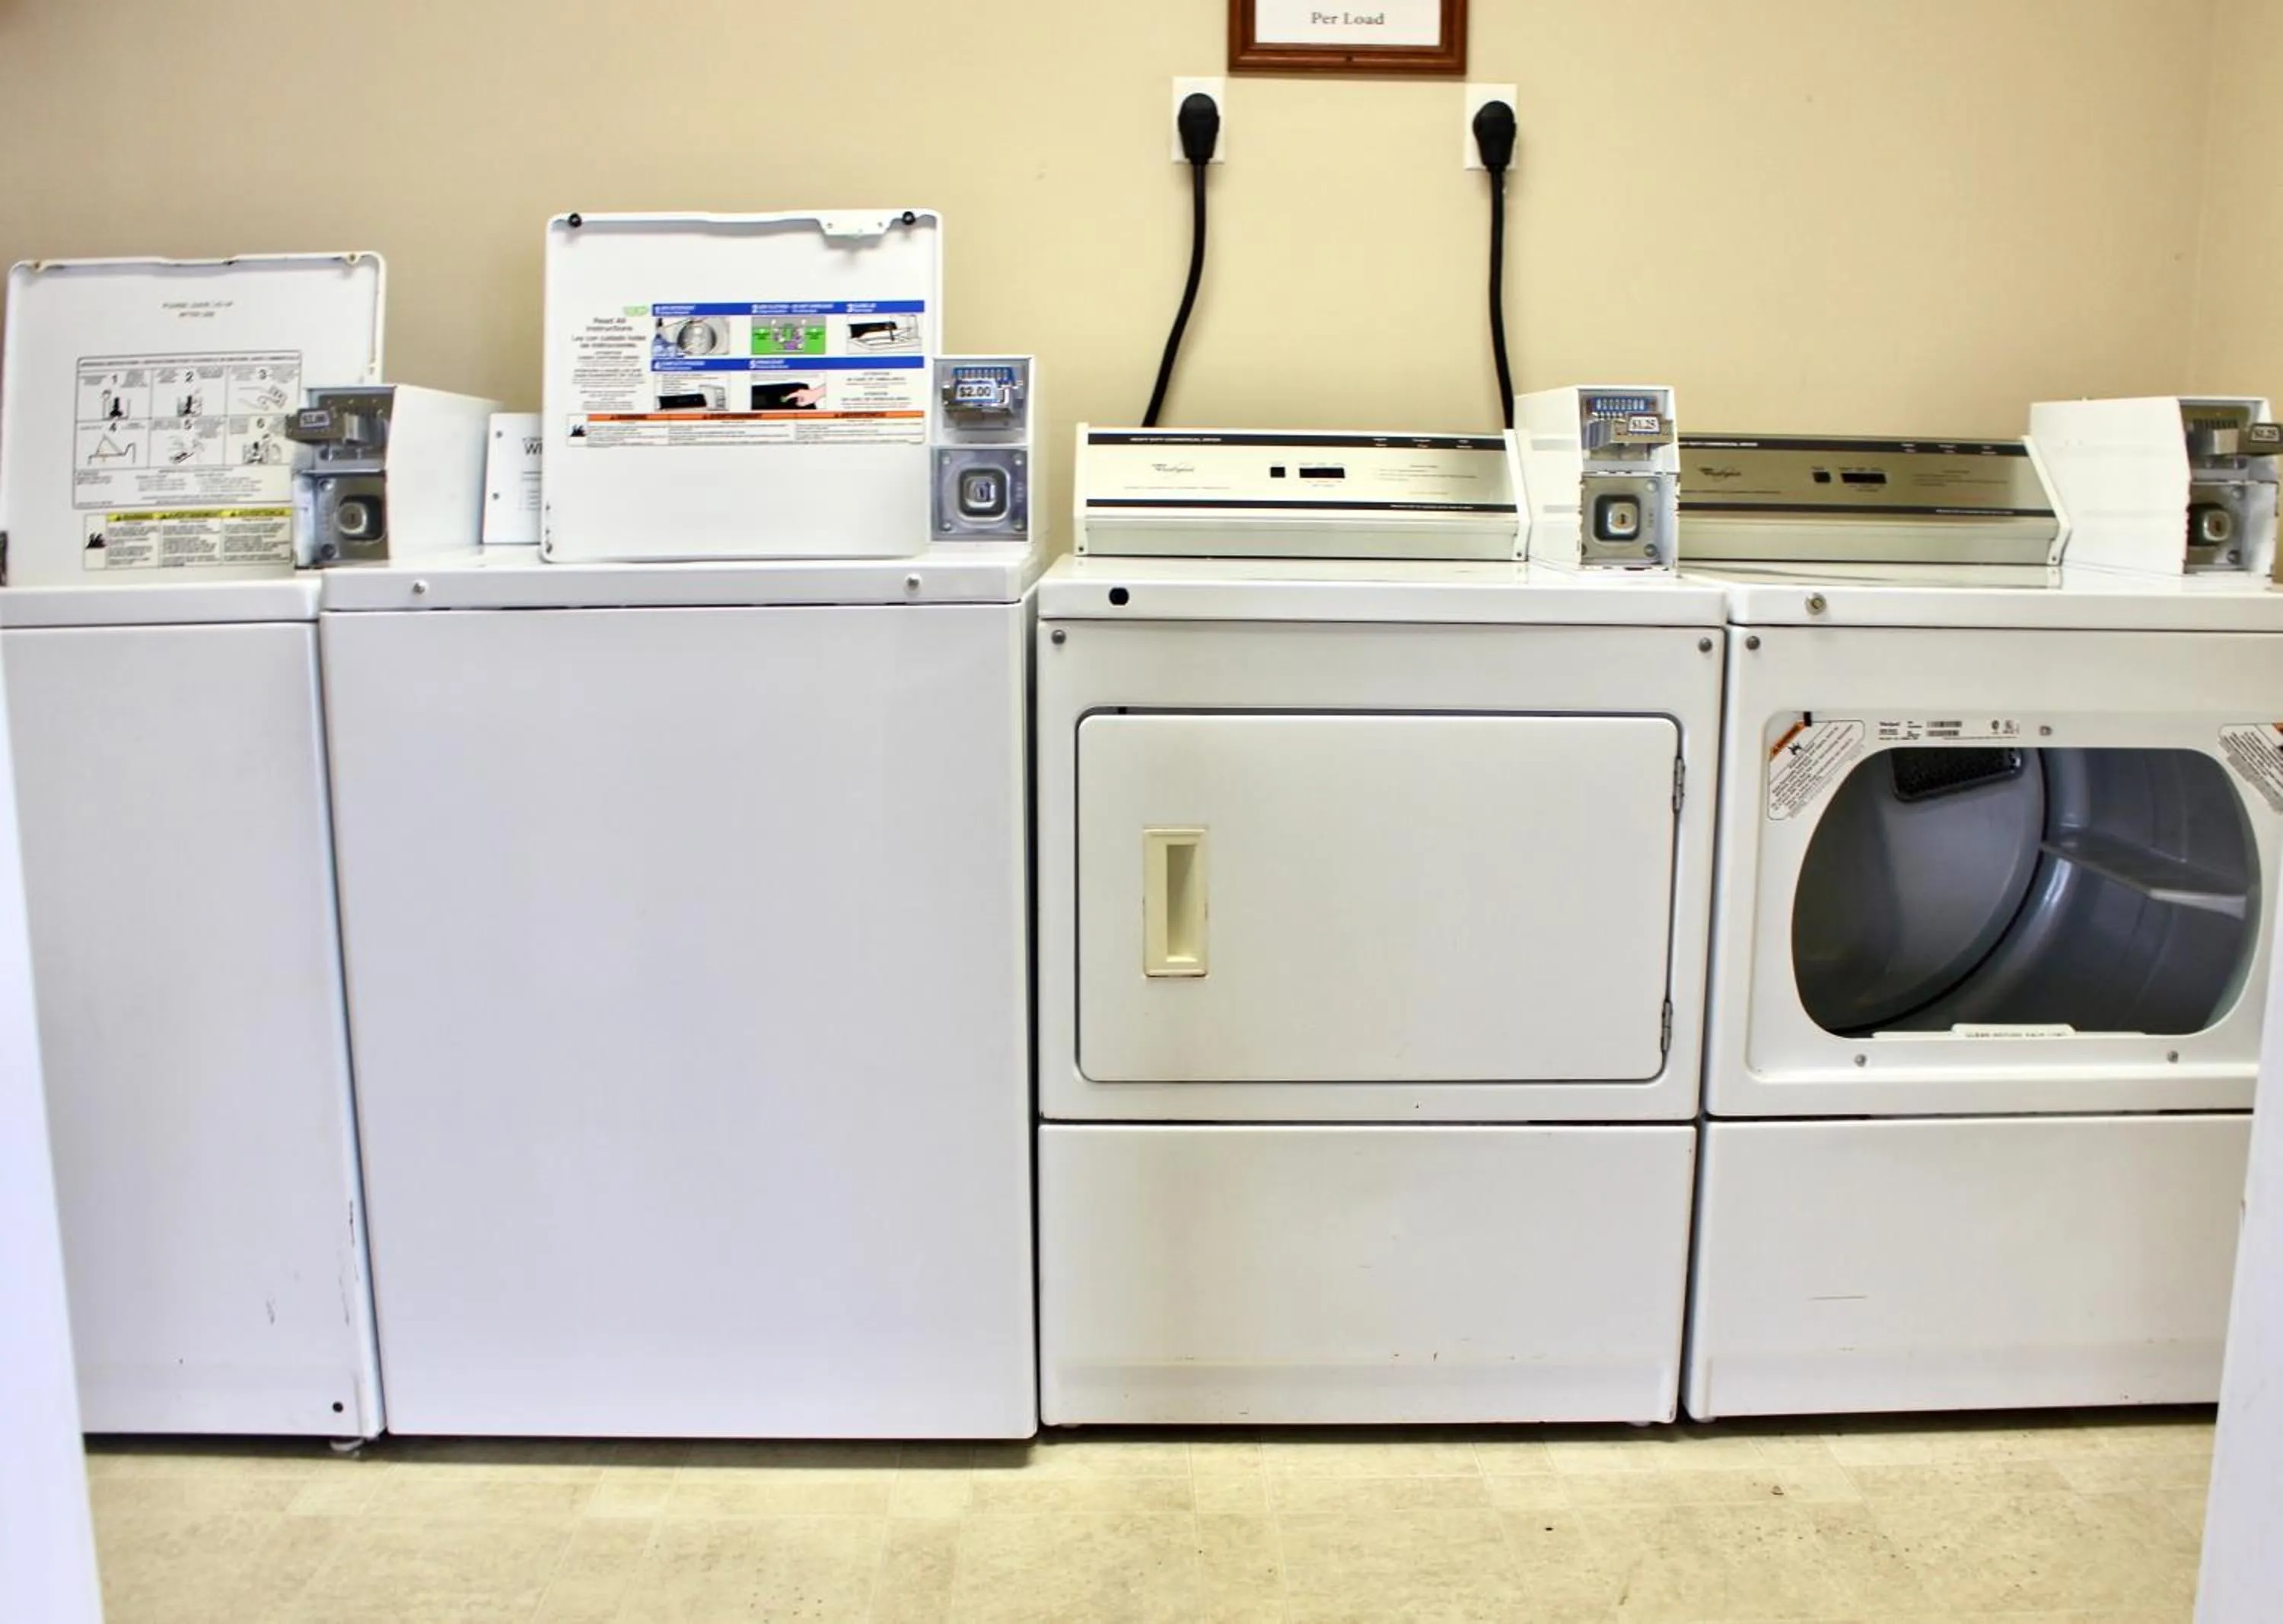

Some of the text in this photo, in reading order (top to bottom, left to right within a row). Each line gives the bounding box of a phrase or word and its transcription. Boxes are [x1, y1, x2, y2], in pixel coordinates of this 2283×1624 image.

[1311, 11, 1384, 25] Per Load
[184, 370, 195, 383] 2
[259, 368, 268, 381] 3
[959, 385, 992, 397] $2.00
